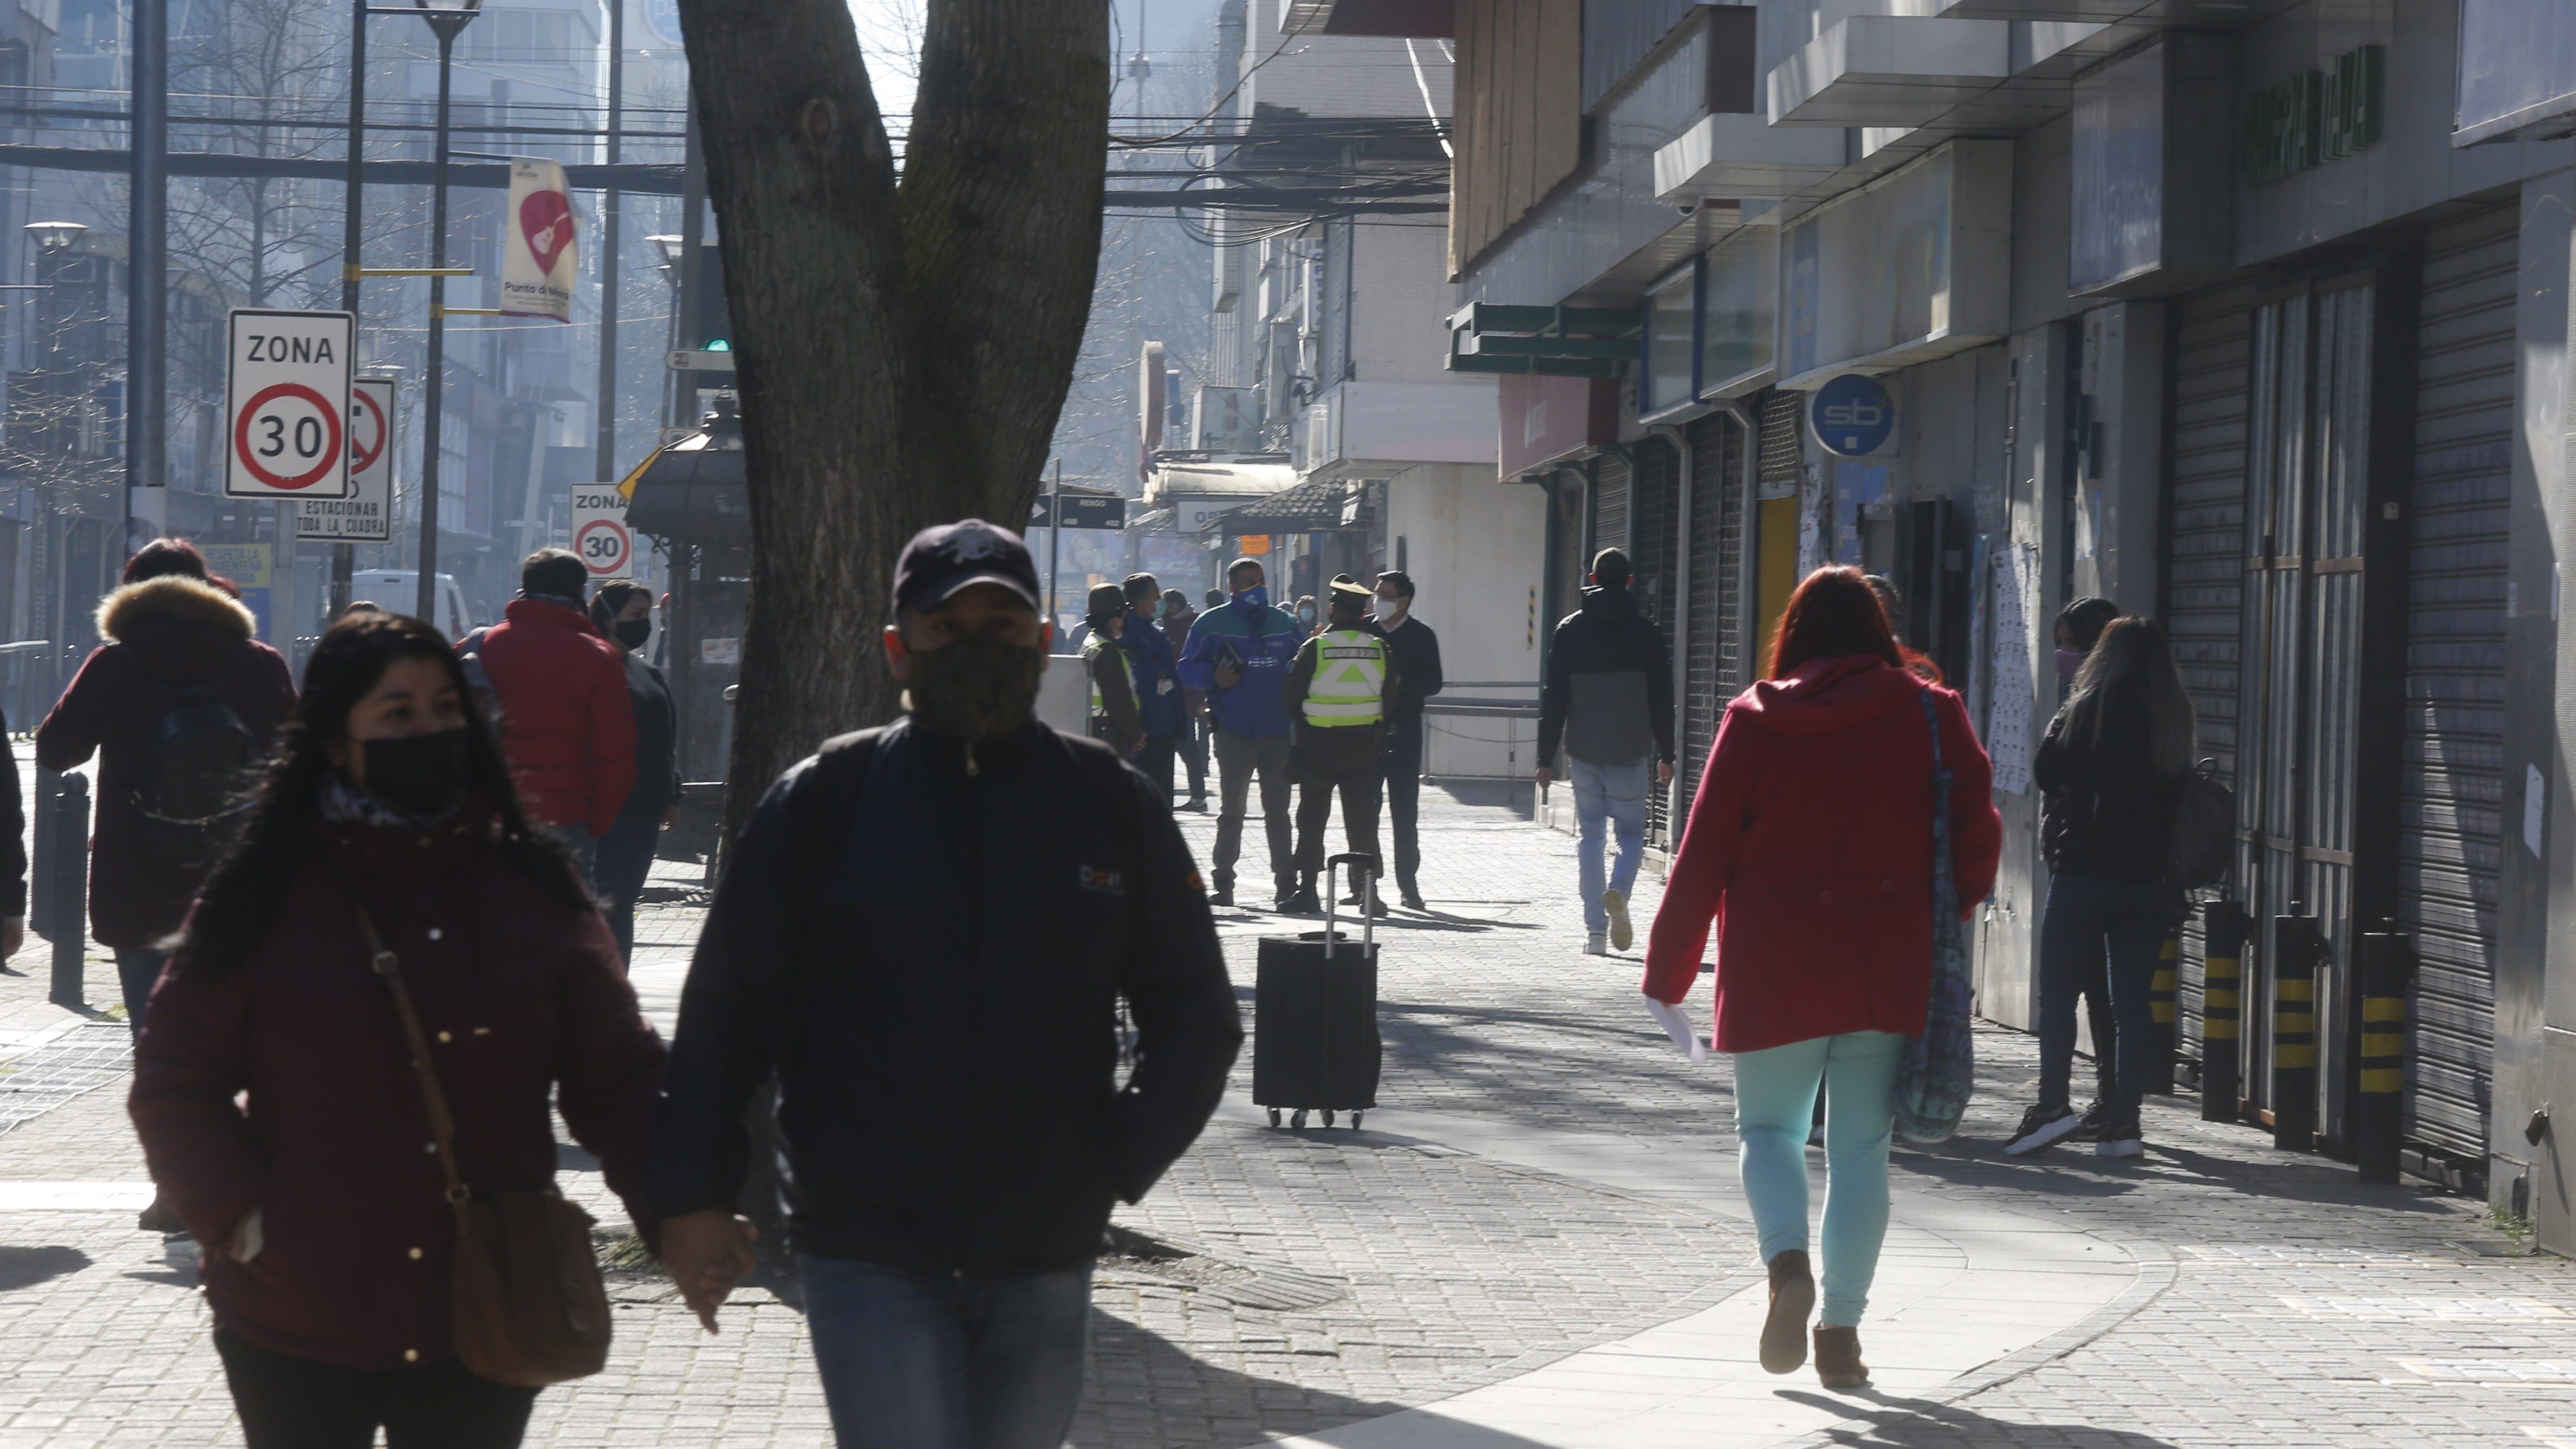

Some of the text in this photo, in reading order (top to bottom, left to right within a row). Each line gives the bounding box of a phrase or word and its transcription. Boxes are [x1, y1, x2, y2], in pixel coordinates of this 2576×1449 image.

[504, 282, 535, 294] Punto
[248, 334, 334, 364] ZONA
[1824, 398, 1881, 426] sb
[258, 415, 322, 458] 30
[305, 501, 378, 517] ESTACIONAR
[575, 495, 627, 509] ZONA
[1079, 499, 1107, 508] RENGO
[297, 517, 385, 534] TODA LA CUADRA
[205, 548, 258, 560] RESPETA LA
[585, 536, 619, 558] 30
